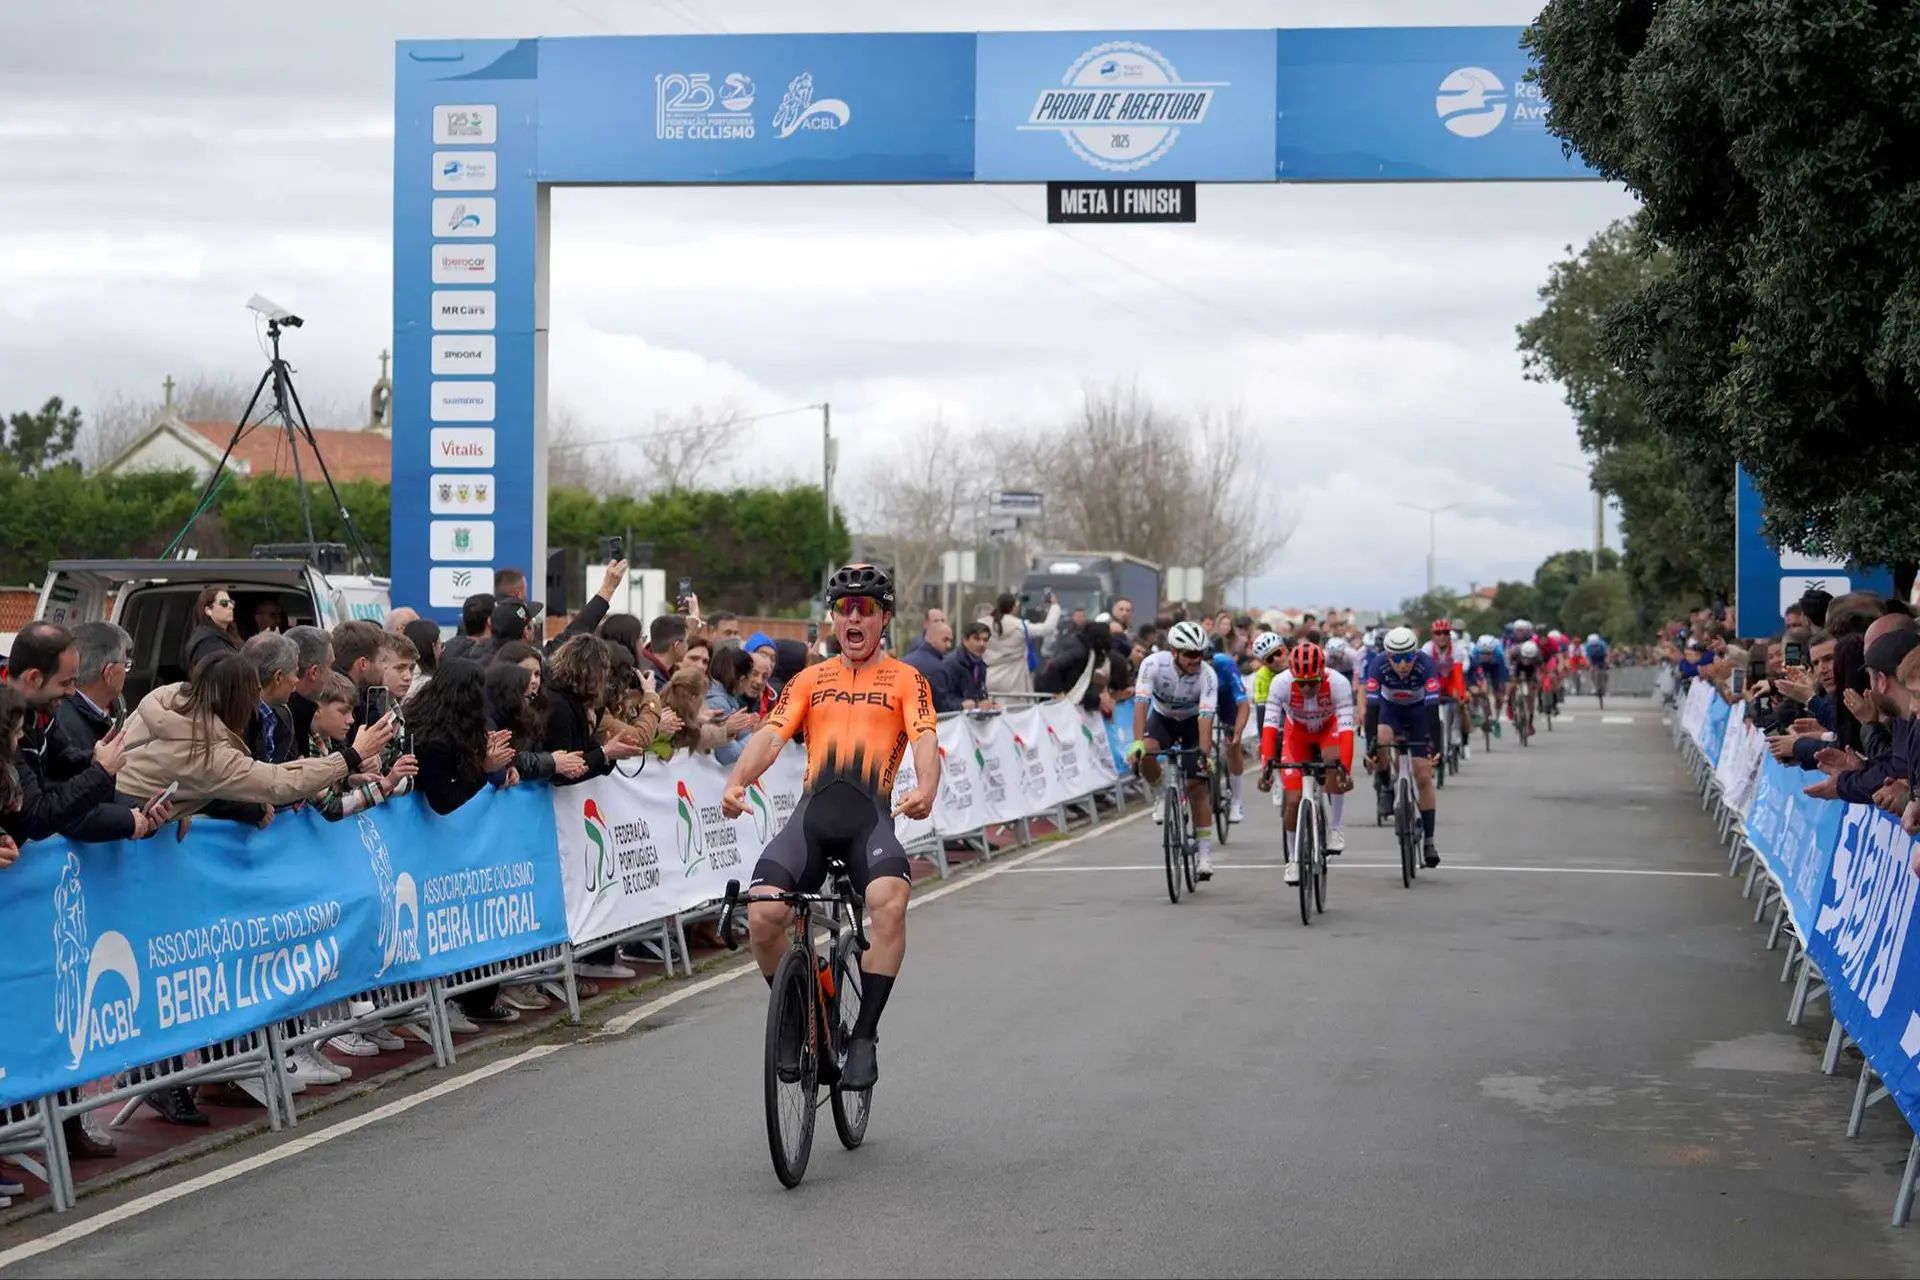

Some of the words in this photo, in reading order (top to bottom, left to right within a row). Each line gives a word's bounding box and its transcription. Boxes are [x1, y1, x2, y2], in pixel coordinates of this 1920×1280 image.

[655, 73, 714, 139] 125
[1037, 93, 1096, 120] PROVA
[1093, 93, 1120, 120] DE
[1117, 93, 1206, 120] ABERTURA
[665, 127, 684, 139] DE
[688, 126, 755, 139] CICLISMO
[801, 117, 837, 130] ACBL
[1111, 134, 1130, 148] 2025
[1061, 189, 1108, 214] META
[1124, 189, 1181, 214] FINISH
[441, 440, 484, 456] Vitalis
[811, 688, 895, 711] EFAPEL
[914, 673, 931, 719] EFAPEL
[882, 730, 909, 788] EFAPEL
[614, 817, 650, 846] FEDERAÇÃO
[619, 844, 659, 872] PORTUGUESA
[709, 852, 719, 871] DE
[717, 847, 742, 868] CICLISMO
[423, 868, 479, 905] ASSOCIAÇÃO
[479, 868, 492, 893] DE
[494, 861, 535, 890] CICLISMO
[623, 874, 633, 895] DE
[632, 867, 660, 893] CICLISMO
[148, 918, 244, 969] ASSOCIAÇÃO
[248, 916, 270, 948] DE
[272, 900, 341, 942] CICLISMO
[426, 900, 473, 955] BEIRA
[475, 891, 541, 942] LITORAL
[394, 929, 421, 965] ACBL
[155, 962, 230, 1030] BEIRA
[235, 935, 341, 1009] LITORAL
[89, 998, 141, 1052] ACBL
